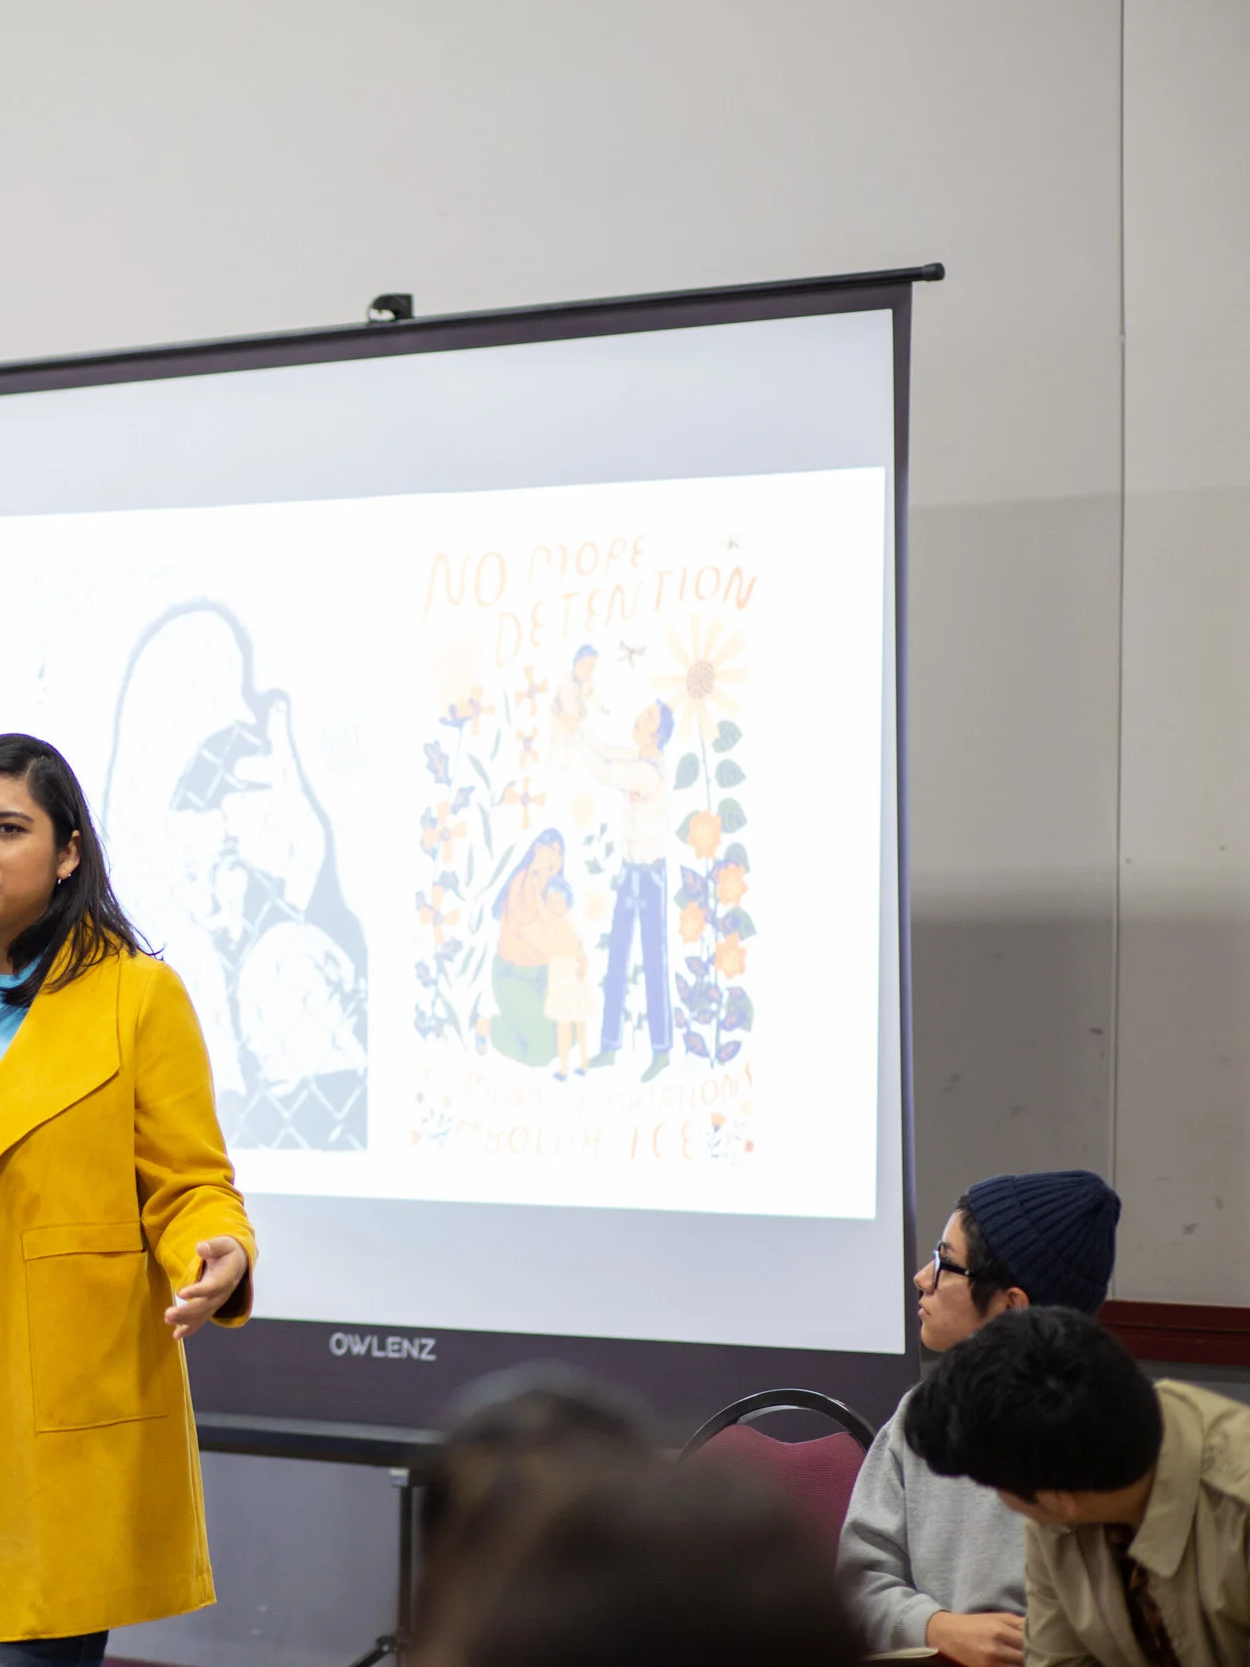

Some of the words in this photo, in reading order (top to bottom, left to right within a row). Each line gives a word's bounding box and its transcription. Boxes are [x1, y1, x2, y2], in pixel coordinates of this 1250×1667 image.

[423, 551, 507, 621] NO
[527, 535, 647, 584] MORE
[496, 566, 757, 667] DETENTION
[631, 1121, 695, 1160] ICE
[329, 1332, 437, 1361] OWLENZ
